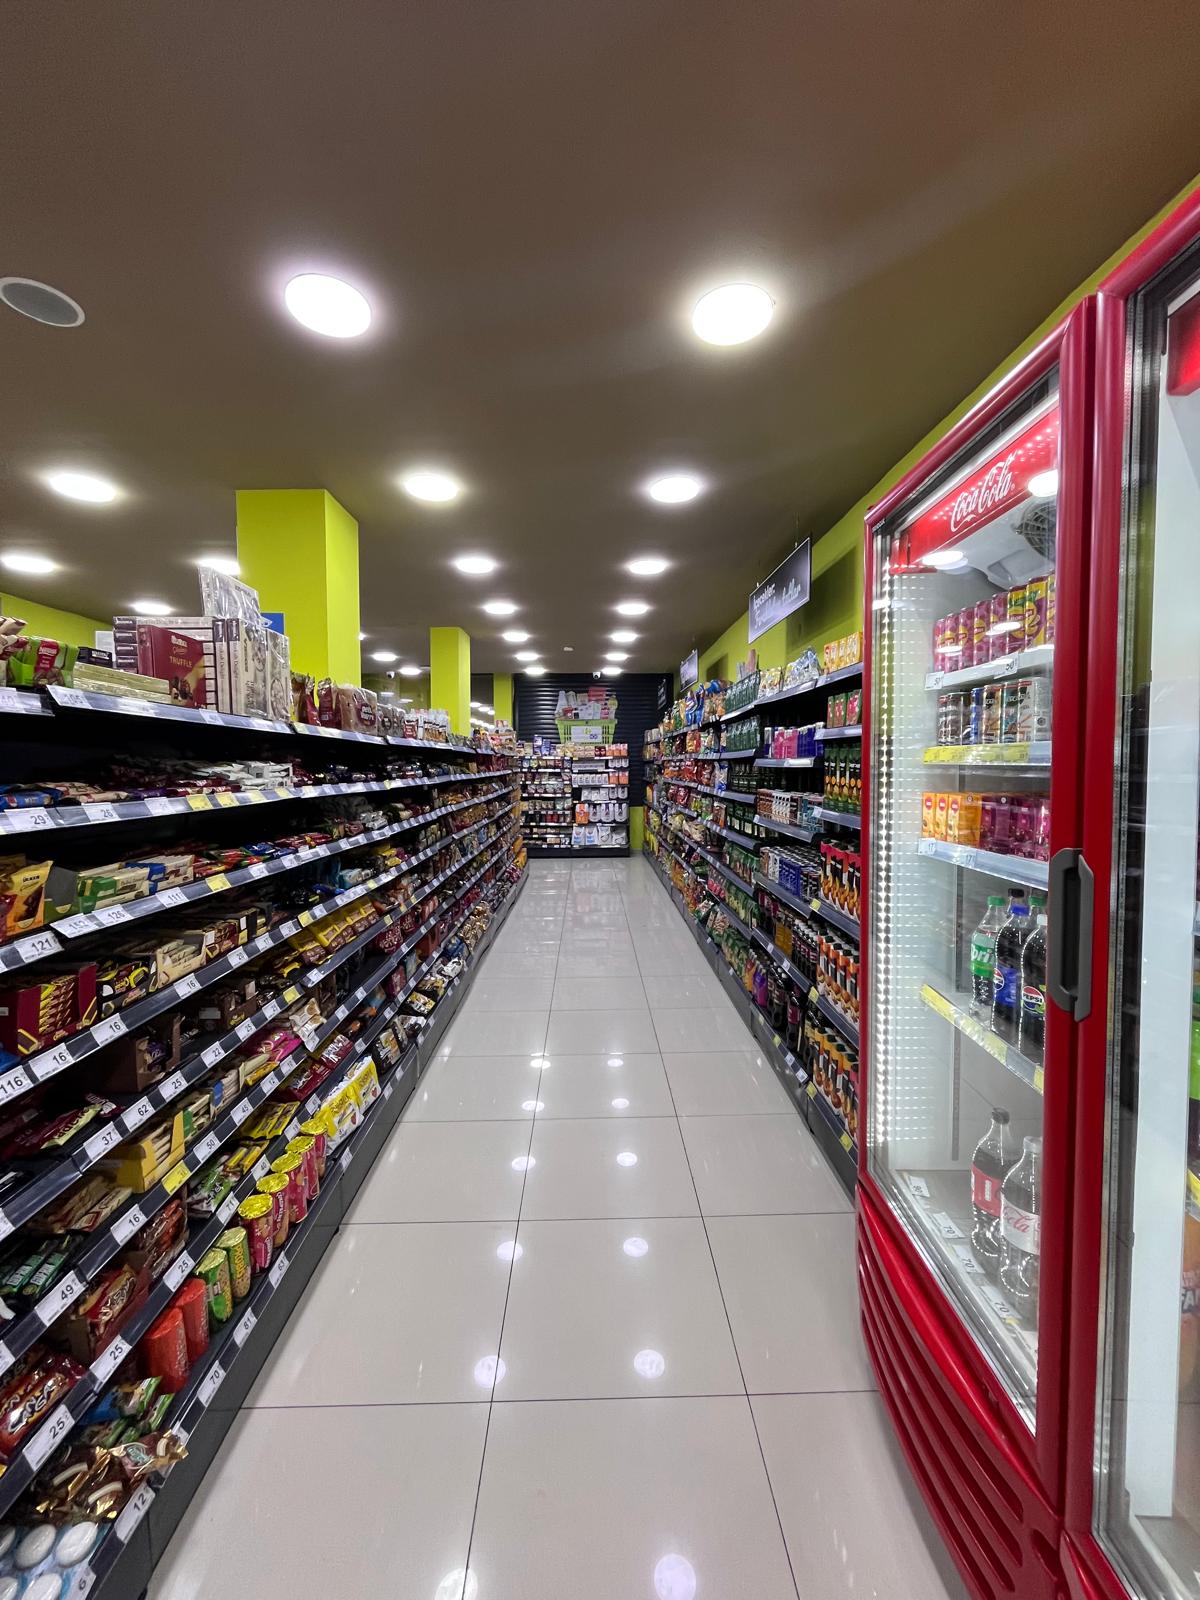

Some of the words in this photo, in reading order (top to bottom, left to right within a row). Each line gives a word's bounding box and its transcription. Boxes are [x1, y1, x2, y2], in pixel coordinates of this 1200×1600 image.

[951, 451, 1017, 532] Coca-Cola
[30, 815, 46, 825] 29
[168, 892, 181, 901] 111
[108, 910, 125, 920] 126
[32, 937, 52, 953] 121
[186, 980, 197, 989] 16
[109, 1021, 121, 1033] 16
[52, 1051, 67, 1065] 16
[213, 1049, 222, 1058] 22
[0, 1076, 23, 1094] 116
[171, 1078, 183, 1090] 25
[137, 1103, 149, 1117] 62
[241, 1103, 250, 1114] 45
[102, 1131, 114, 1146] 37
[206, 1139, 216, 1150] 50
[260, 1161, 268, 1171] 40
[128, 1215, 140, 1228] 16
[177, 1260, 190, 1274] 25
[60, 1285, 75, 1301] 49
[109, 1343, 124, 1361] 25
[209, 1371, 221, 1385] 70
[49, 1417, 65, 1439] 25
[133, 1492, 147, 1512] 12
